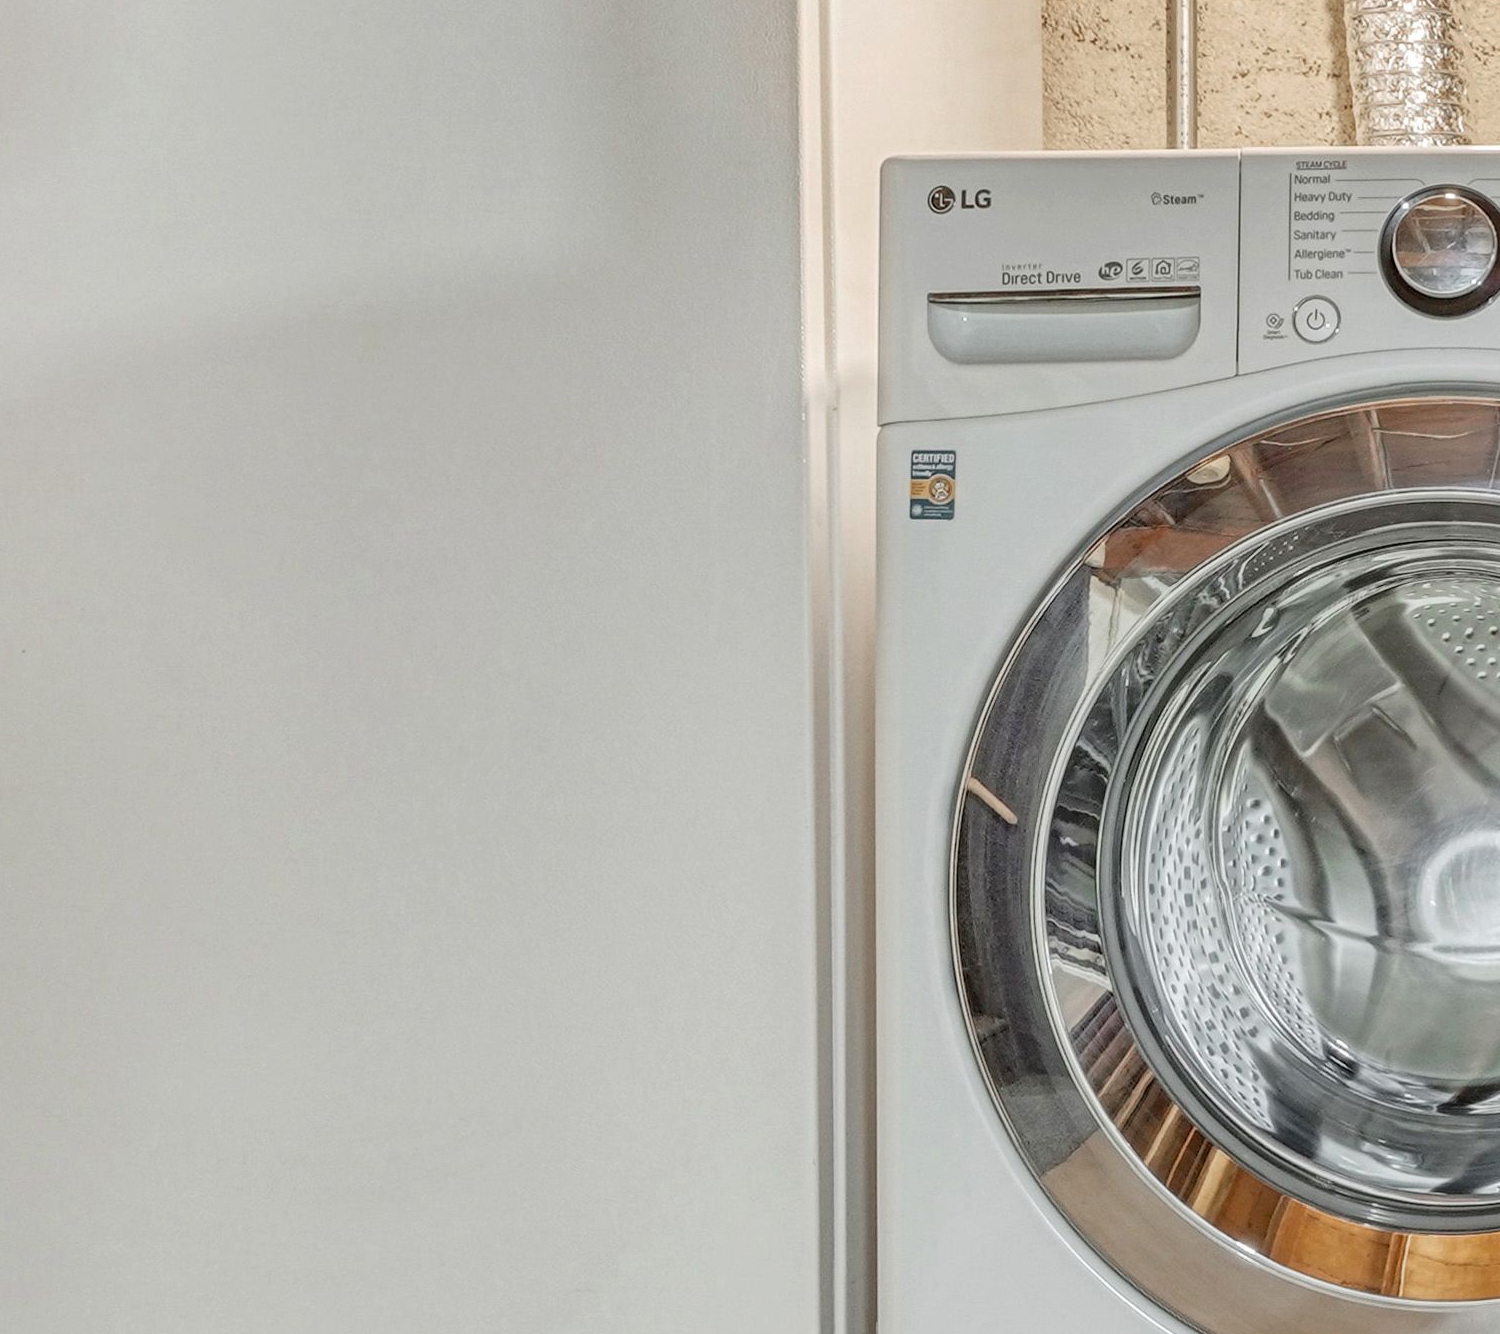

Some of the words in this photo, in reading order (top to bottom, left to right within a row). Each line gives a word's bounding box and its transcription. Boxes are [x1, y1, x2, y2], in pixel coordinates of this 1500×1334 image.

[1296, 161, 1322, 169] STEAM
[1294, 174, 1331, 184] Normal
[961, 189, 992, 209] LG
[1294, 192, 1326, 204] Heavy
[1328, 192, 1352, 202] Duty
[1294, 211, 1335, 222] Bedding
[1293, 230, 1336, 242] Sanitary
[1002, 271, 1043, 286] Direct
[1046, 270, 1081, 285] Drive
[1295, 269, 1313, 280] Tub
[1314, 269, 1344, 280] Clean
[913, 453, 955, 463] CERTIFIED
